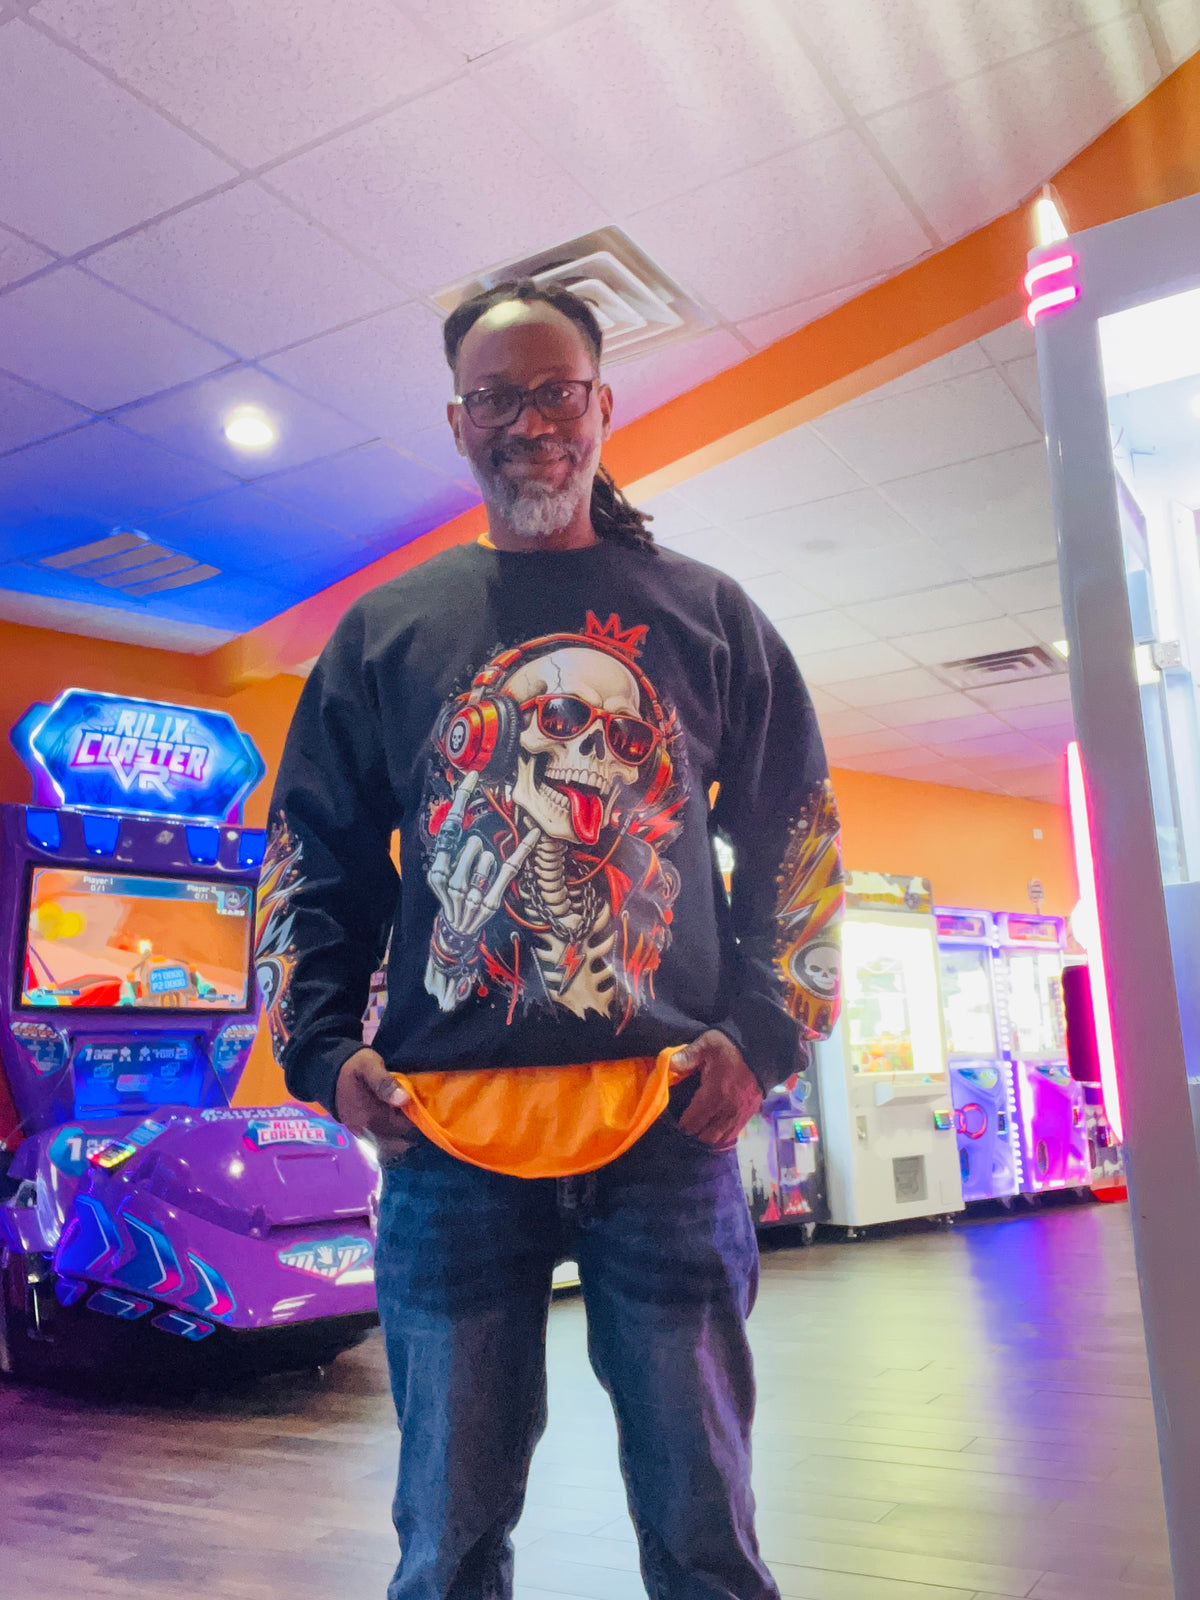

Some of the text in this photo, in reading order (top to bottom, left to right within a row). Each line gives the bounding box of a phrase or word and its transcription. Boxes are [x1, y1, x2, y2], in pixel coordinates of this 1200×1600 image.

[114, 709, 190, 744] RILIX
[71, 730, 208, 780] COASTER
[108, 754, 177, 800] VR
[260, 1128, 325, 1143] COASTER
[273, 1120, 309, 1131] RILIX
[66, 1137, 82, 1162] 1
